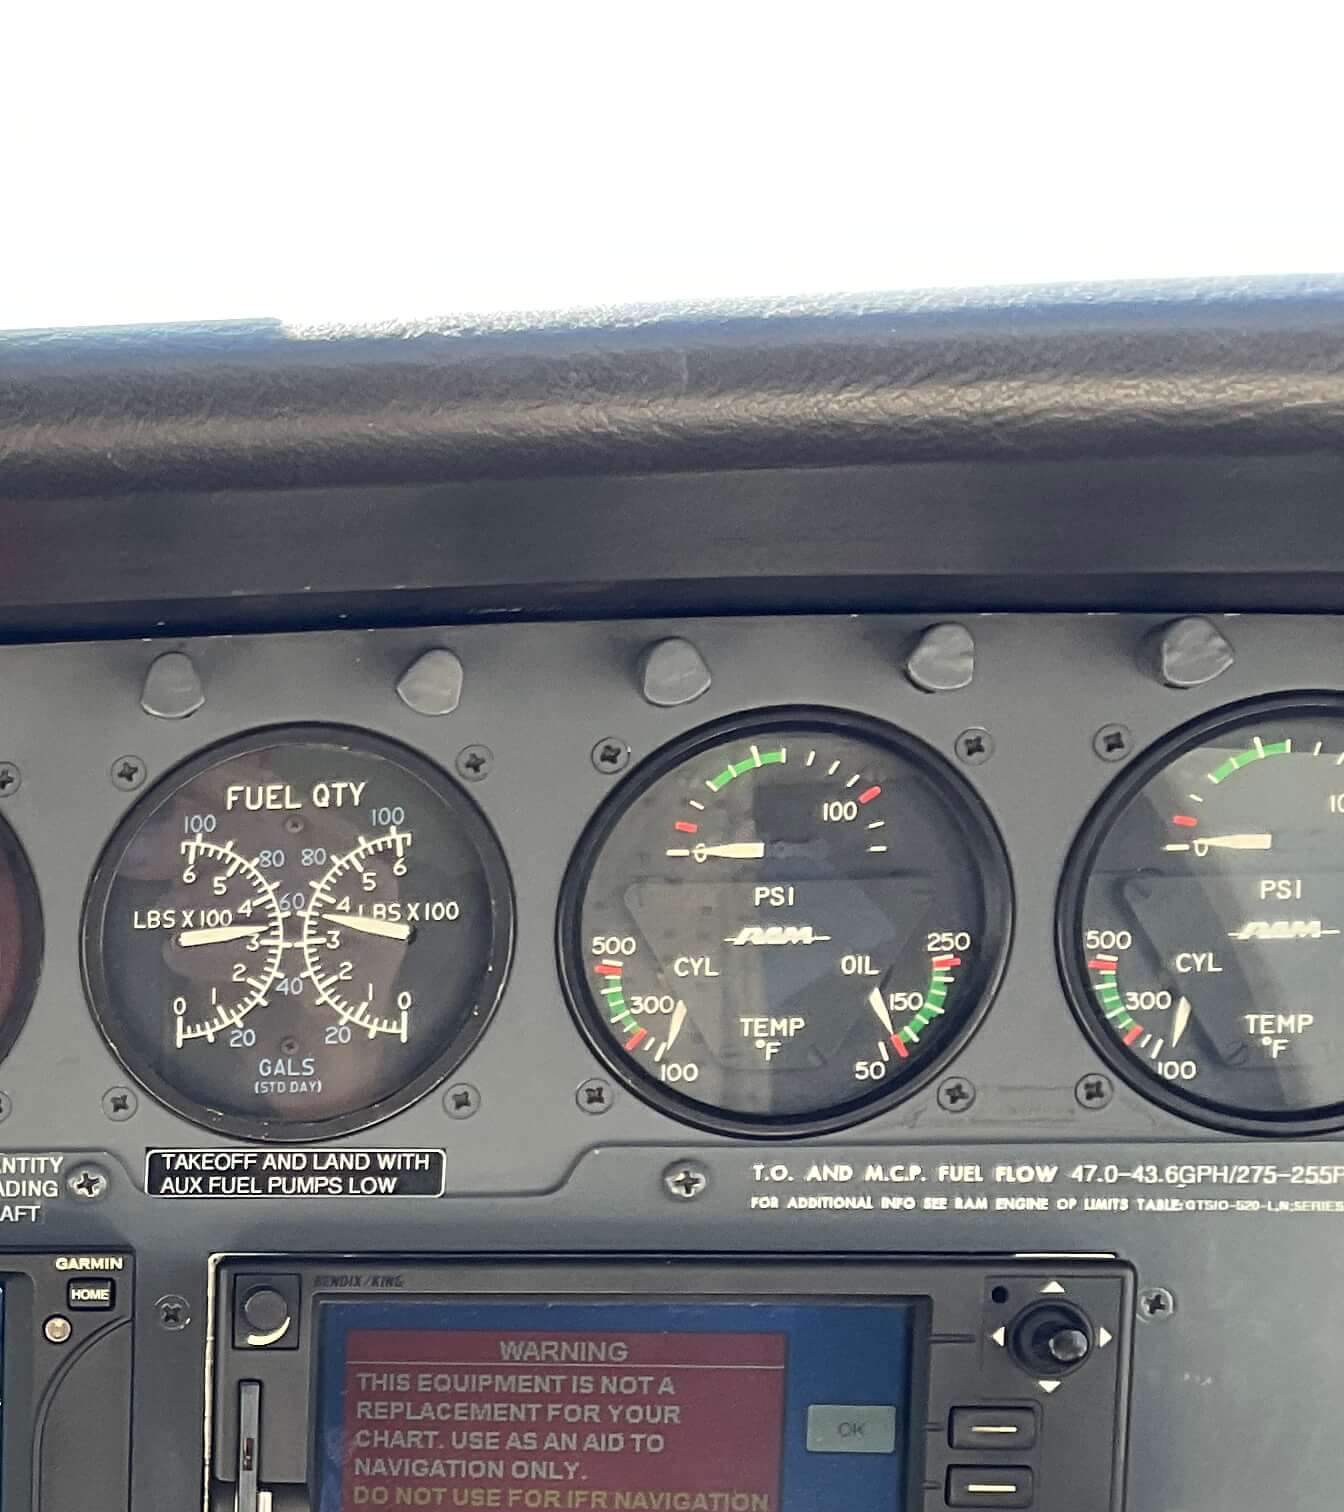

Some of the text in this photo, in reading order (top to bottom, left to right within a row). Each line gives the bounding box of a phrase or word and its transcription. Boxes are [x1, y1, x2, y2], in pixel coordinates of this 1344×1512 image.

[227, 783, 366, 810] FUEL QTY
[754, 887, 795, 906] PSI
[673, 957, 719, 976] CYL
[841, 956, 879, 975] OIL
[740, 1018, 805, 1036] TEMP
[161, 1153, 430, 1172] TAKEOFF AND LAND WITH
[160, 1177, 396, 1194] AUX FUEL PUMPS LOW
[500, 1341, 628, 1362] WARNING
[356, 1402, 680, 1425] REPLACEMENT FOR YOUR
